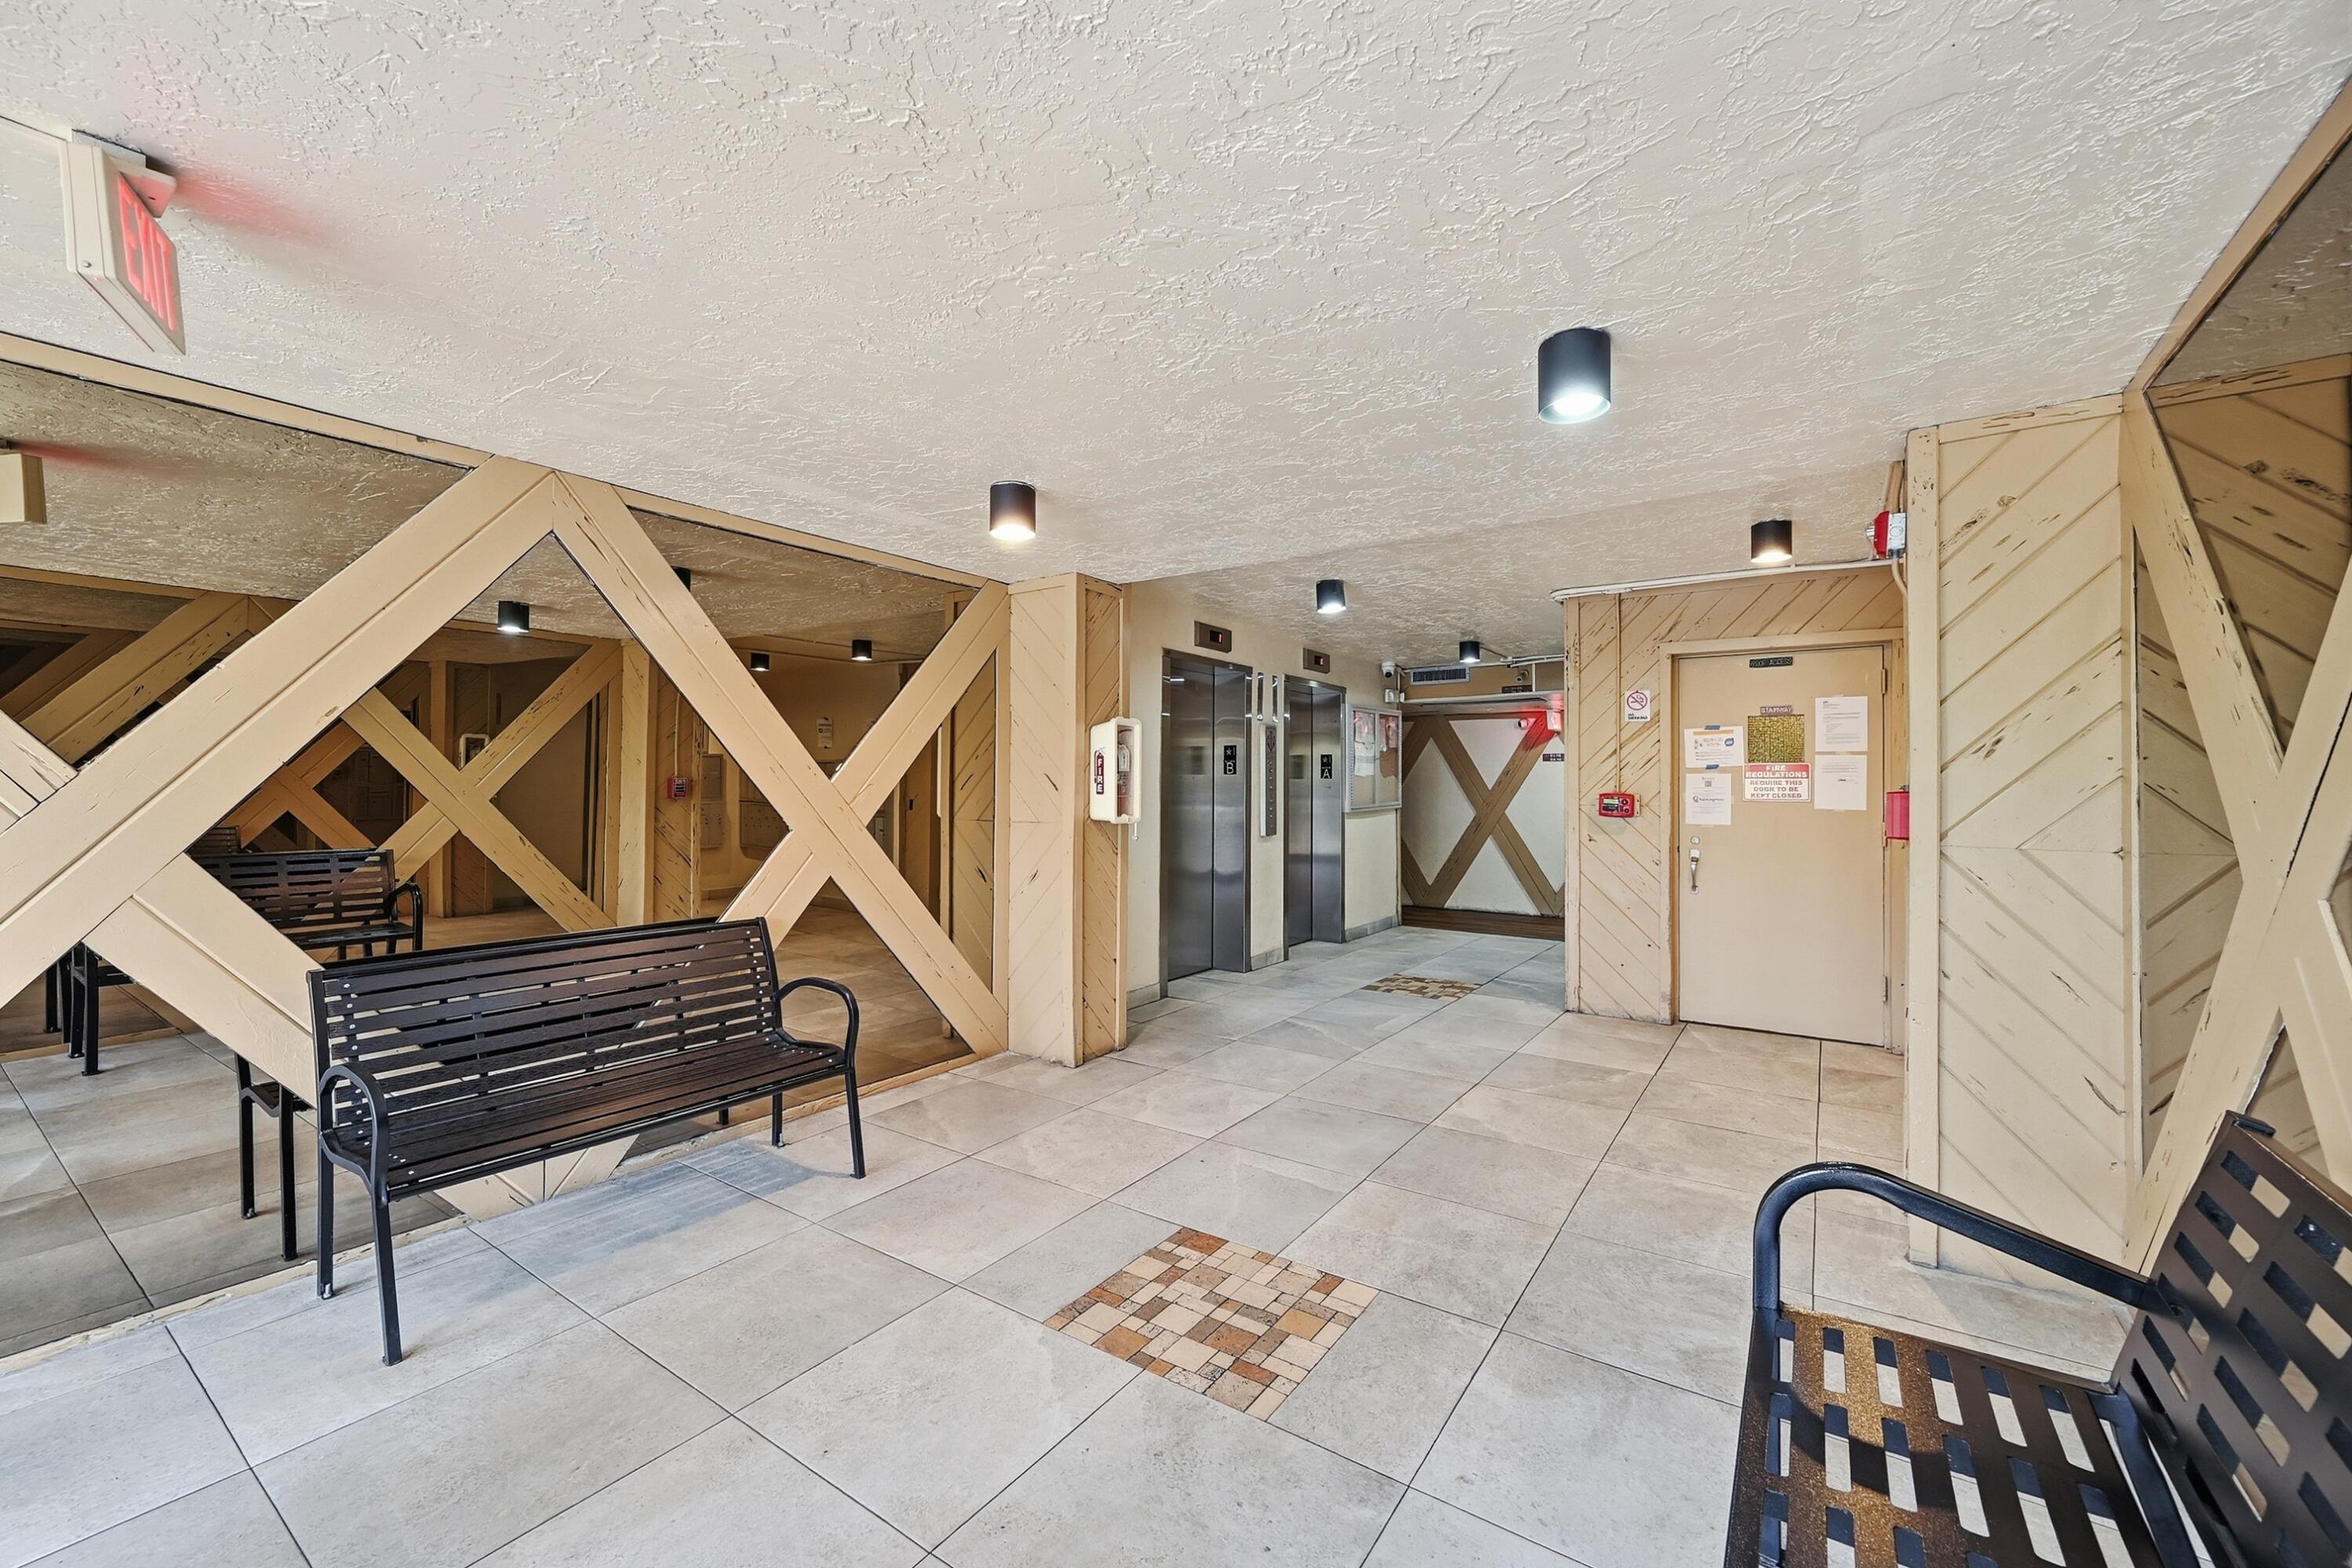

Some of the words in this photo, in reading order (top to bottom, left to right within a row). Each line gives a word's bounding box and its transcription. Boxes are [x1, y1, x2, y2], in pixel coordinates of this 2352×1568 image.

[118, 176, 176, 330] EXIT
[1226, 762, 1234, 774] B
[1322, 768, 1330, 779] A
